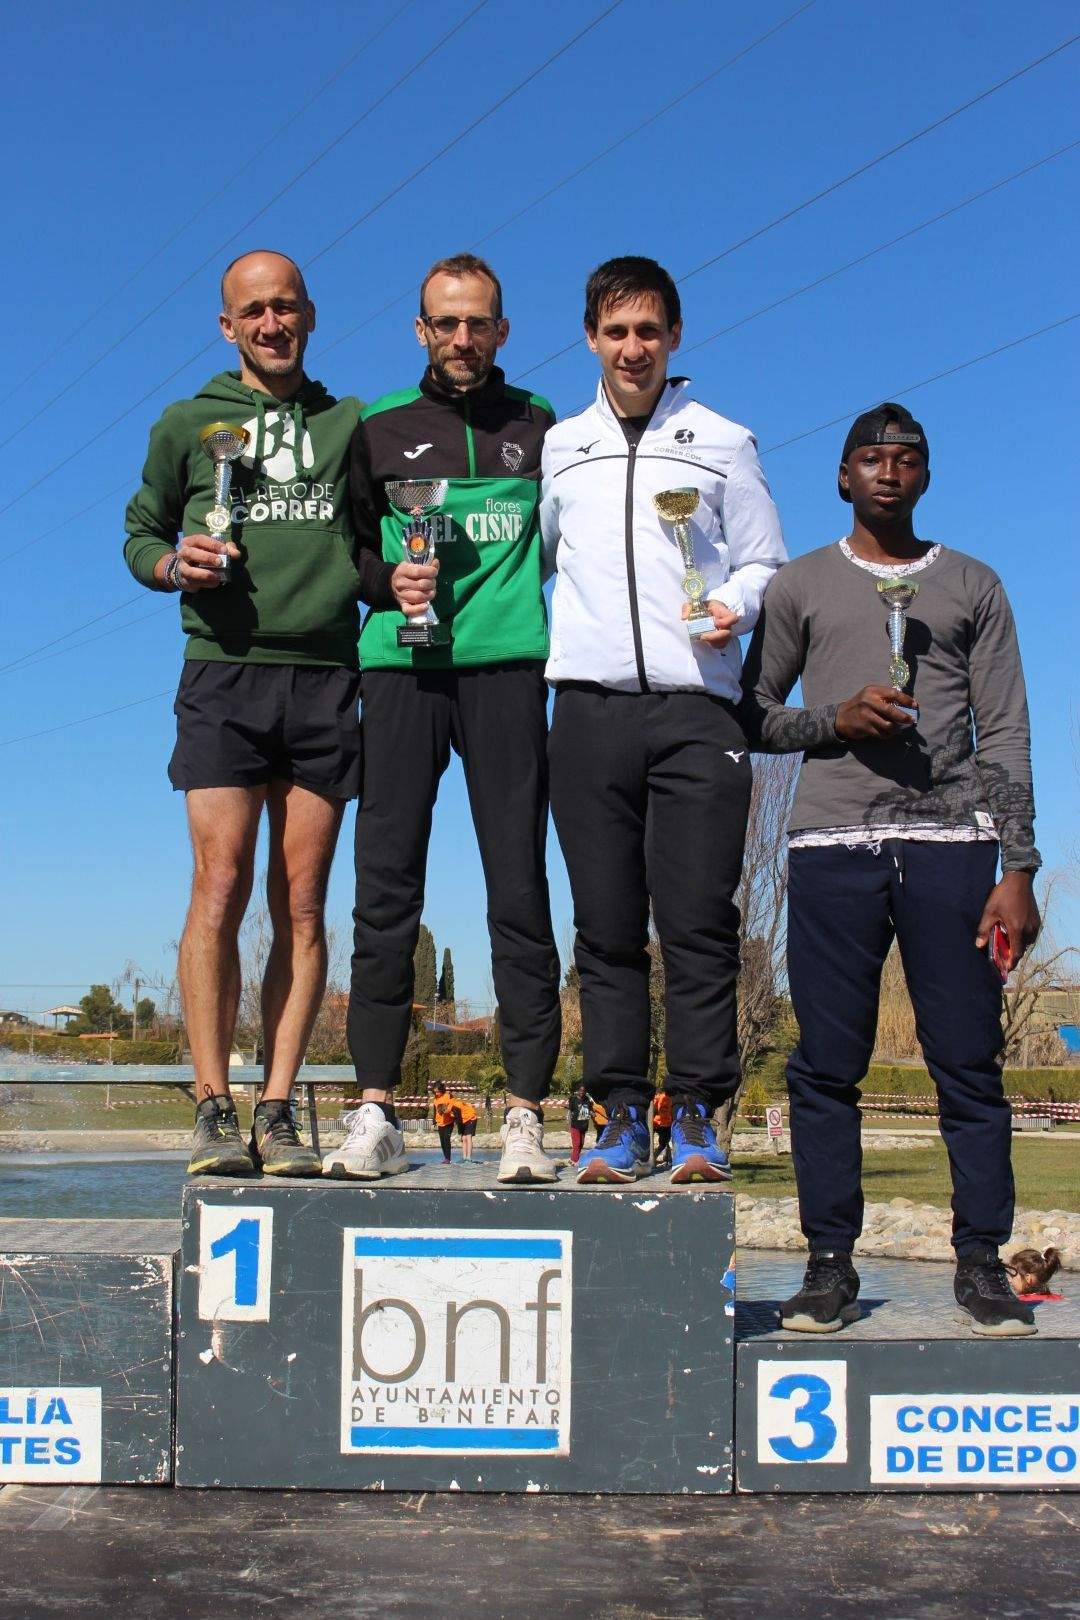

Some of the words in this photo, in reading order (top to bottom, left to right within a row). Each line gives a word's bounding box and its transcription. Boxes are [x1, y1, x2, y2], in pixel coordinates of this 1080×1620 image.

[228, 486, 251, 504] EL
[256, 482, 307, 501] RETO
[311, 483, 334, 500] DE
[486, 498, 521, 513] flores
[230, 499, 334, 523] CORRER
[430, 514, 458, 543] EL
[210, 1218, 260, 1306] 1
[352, 1267, 562, 1385] bnf
[351, 1386, 561, 1405] AYUNTAMIENTO
[351, 1406, 385, 1423] DE
[768, 1373, 838, 1462] 3
[896, 1404, 1080, 1433] CONCEJ
[0, 1436, 82, 1466] TES
[886, 1445, 944, 1473] DE
[957, 1445, 1077, 1473] DEPO
